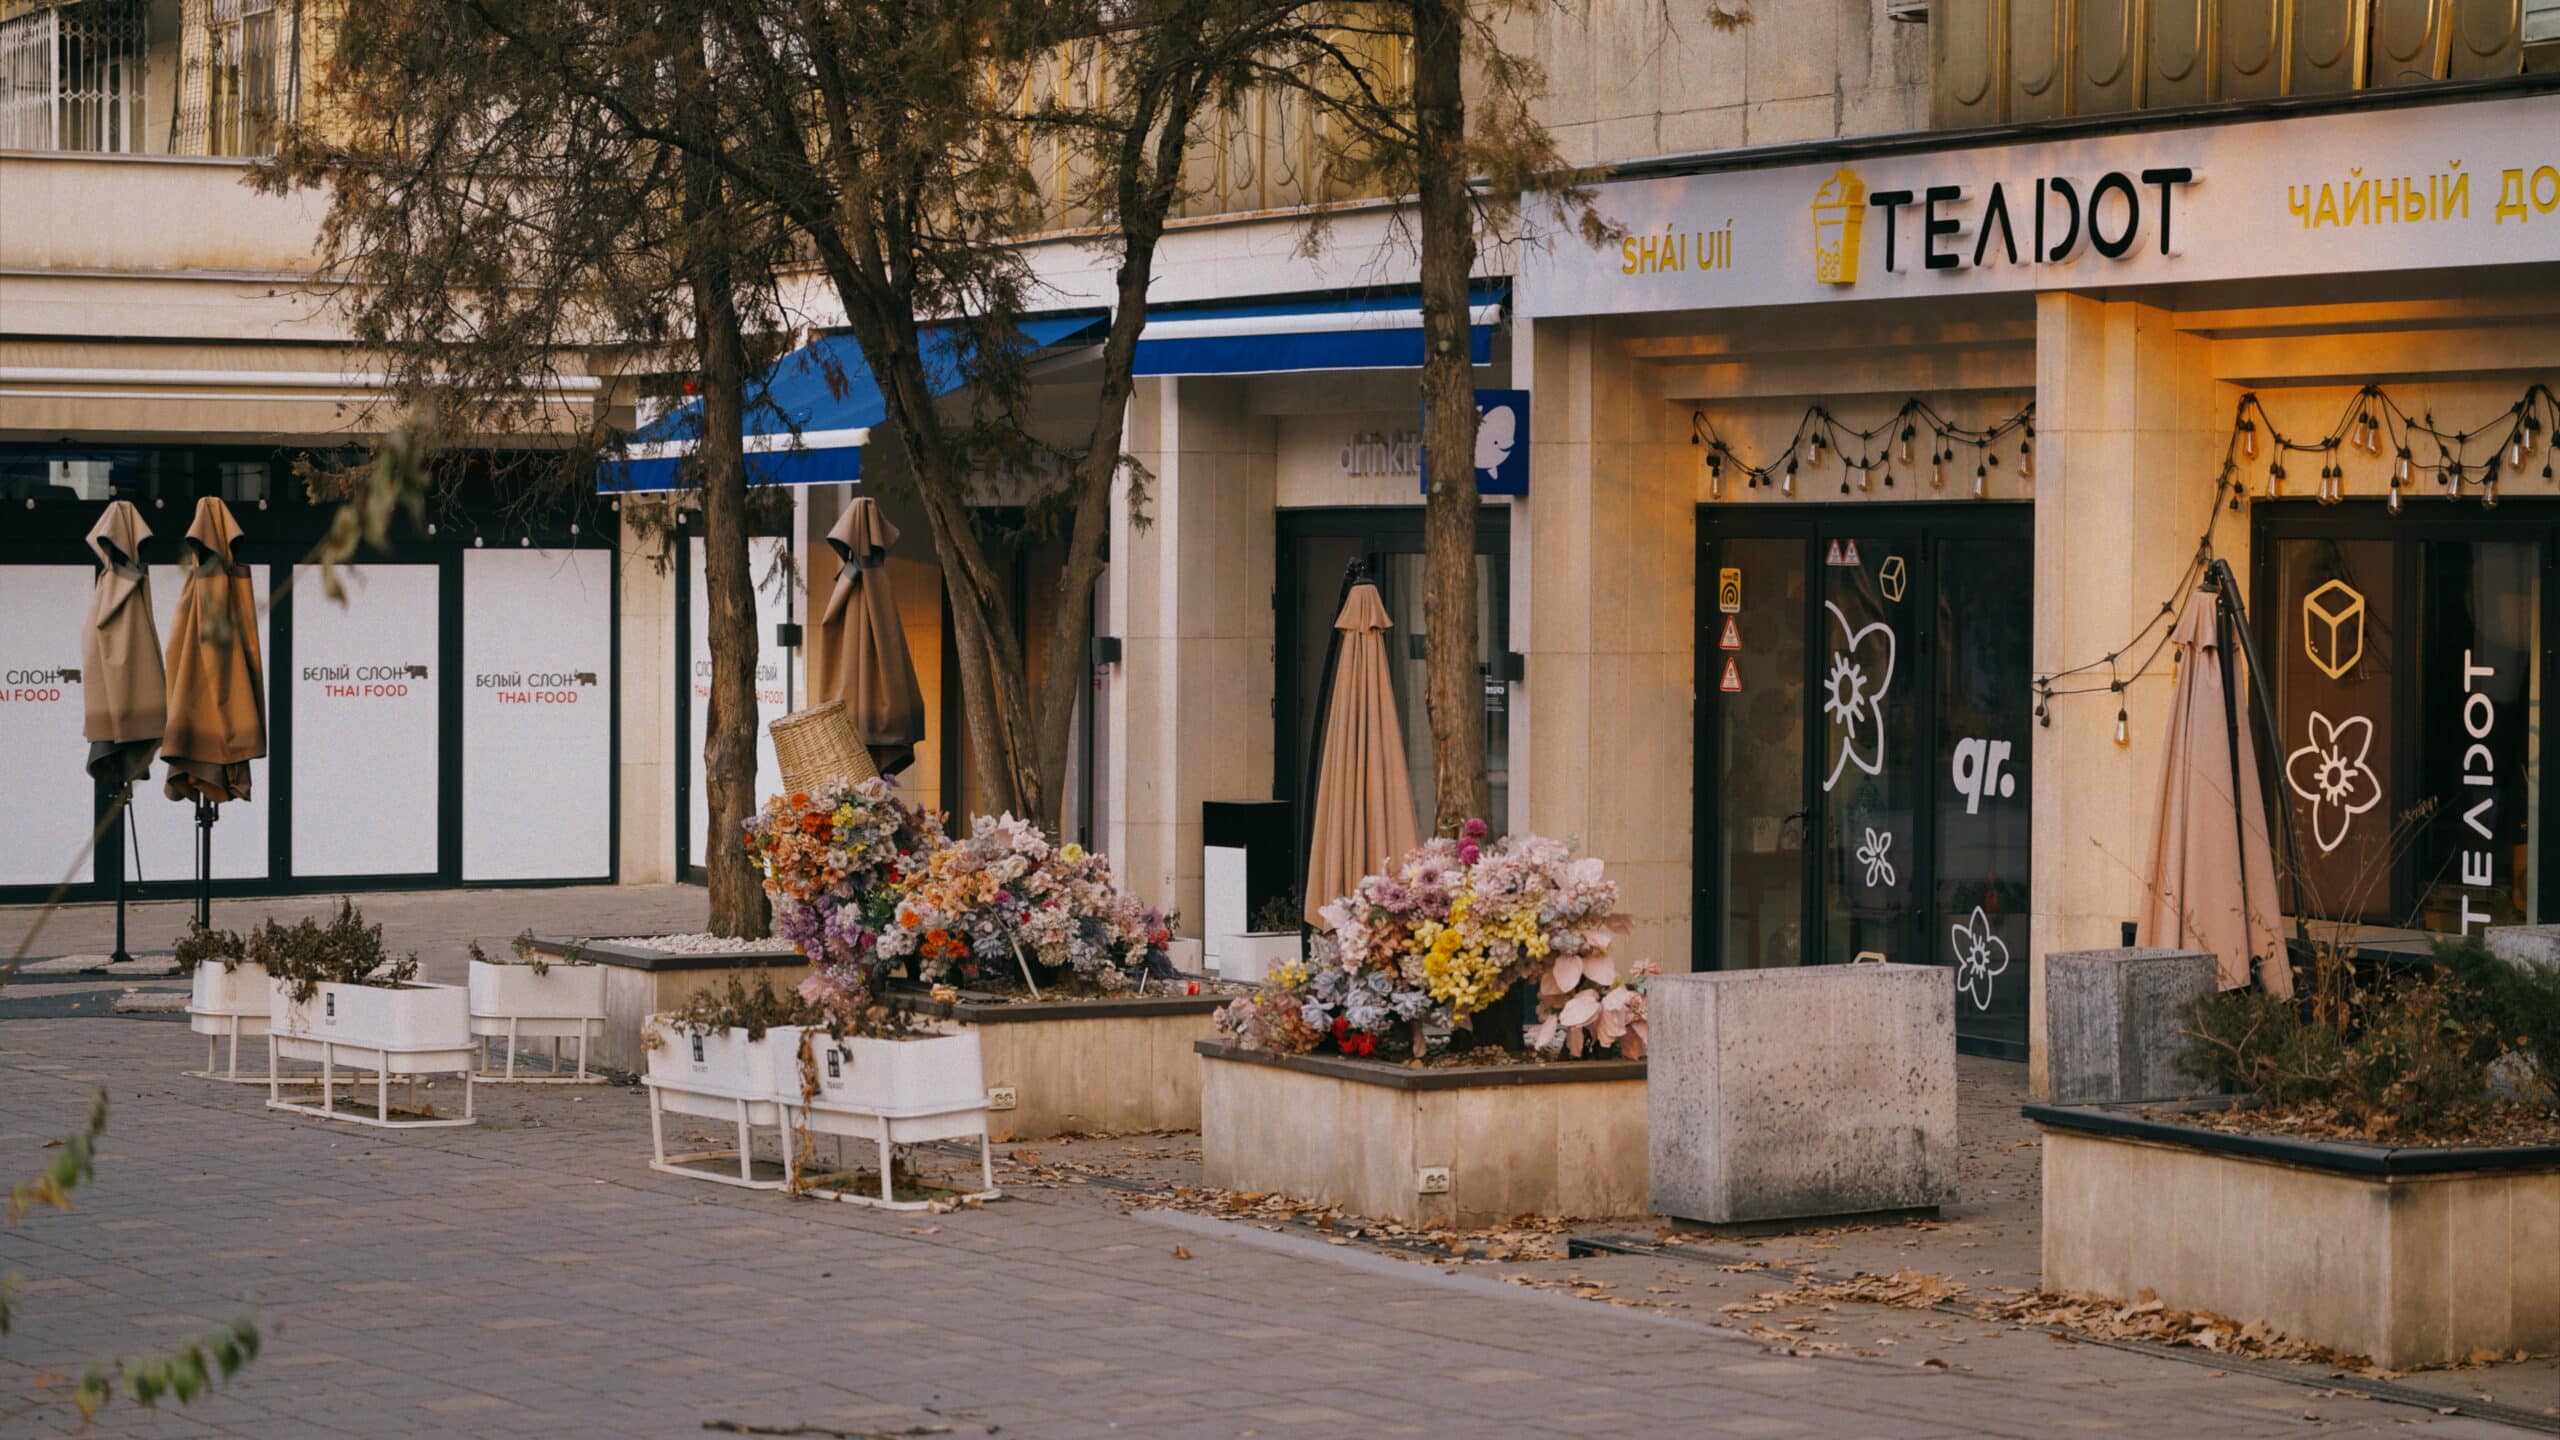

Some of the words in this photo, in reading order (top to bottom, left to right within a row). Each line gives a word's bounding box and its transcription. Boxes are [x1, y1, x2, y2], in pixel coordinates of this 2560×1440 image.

[2288, 159, 2469, 229] ЧАЙНЫЙ
[2495, 165, 2560, 225] ДО
[1869, 167, 2199, 274] TEADOT
[1622, 223, 1686, 276] SHÁI
[1339, 432, 1421, 474] drinkit
[6, 669, 55, 685] СЛОН
[303, 664, 350, 681] БЕЛЫЙ
[356, 666, 402, 681] СЛОН
[476, 671, 521, 688] БЕЛЫЙ
[528, 673, 573, 688] СЛОН
[757, 662, 777, 681] ЕЛЫЙ
[14, 688, 61, 702] FOOD
[325, 685, 359, 697] THAI
[365, 684, 408, 697] FOOD
[496, 691, 531, 704] THAI
[535, 691, 578, 704] FOOD
[765, 690, 784, 704] FOOD
[1952, 737, 2015, 815] qr.
[2461, 648, 2495, 936] TEADOT
